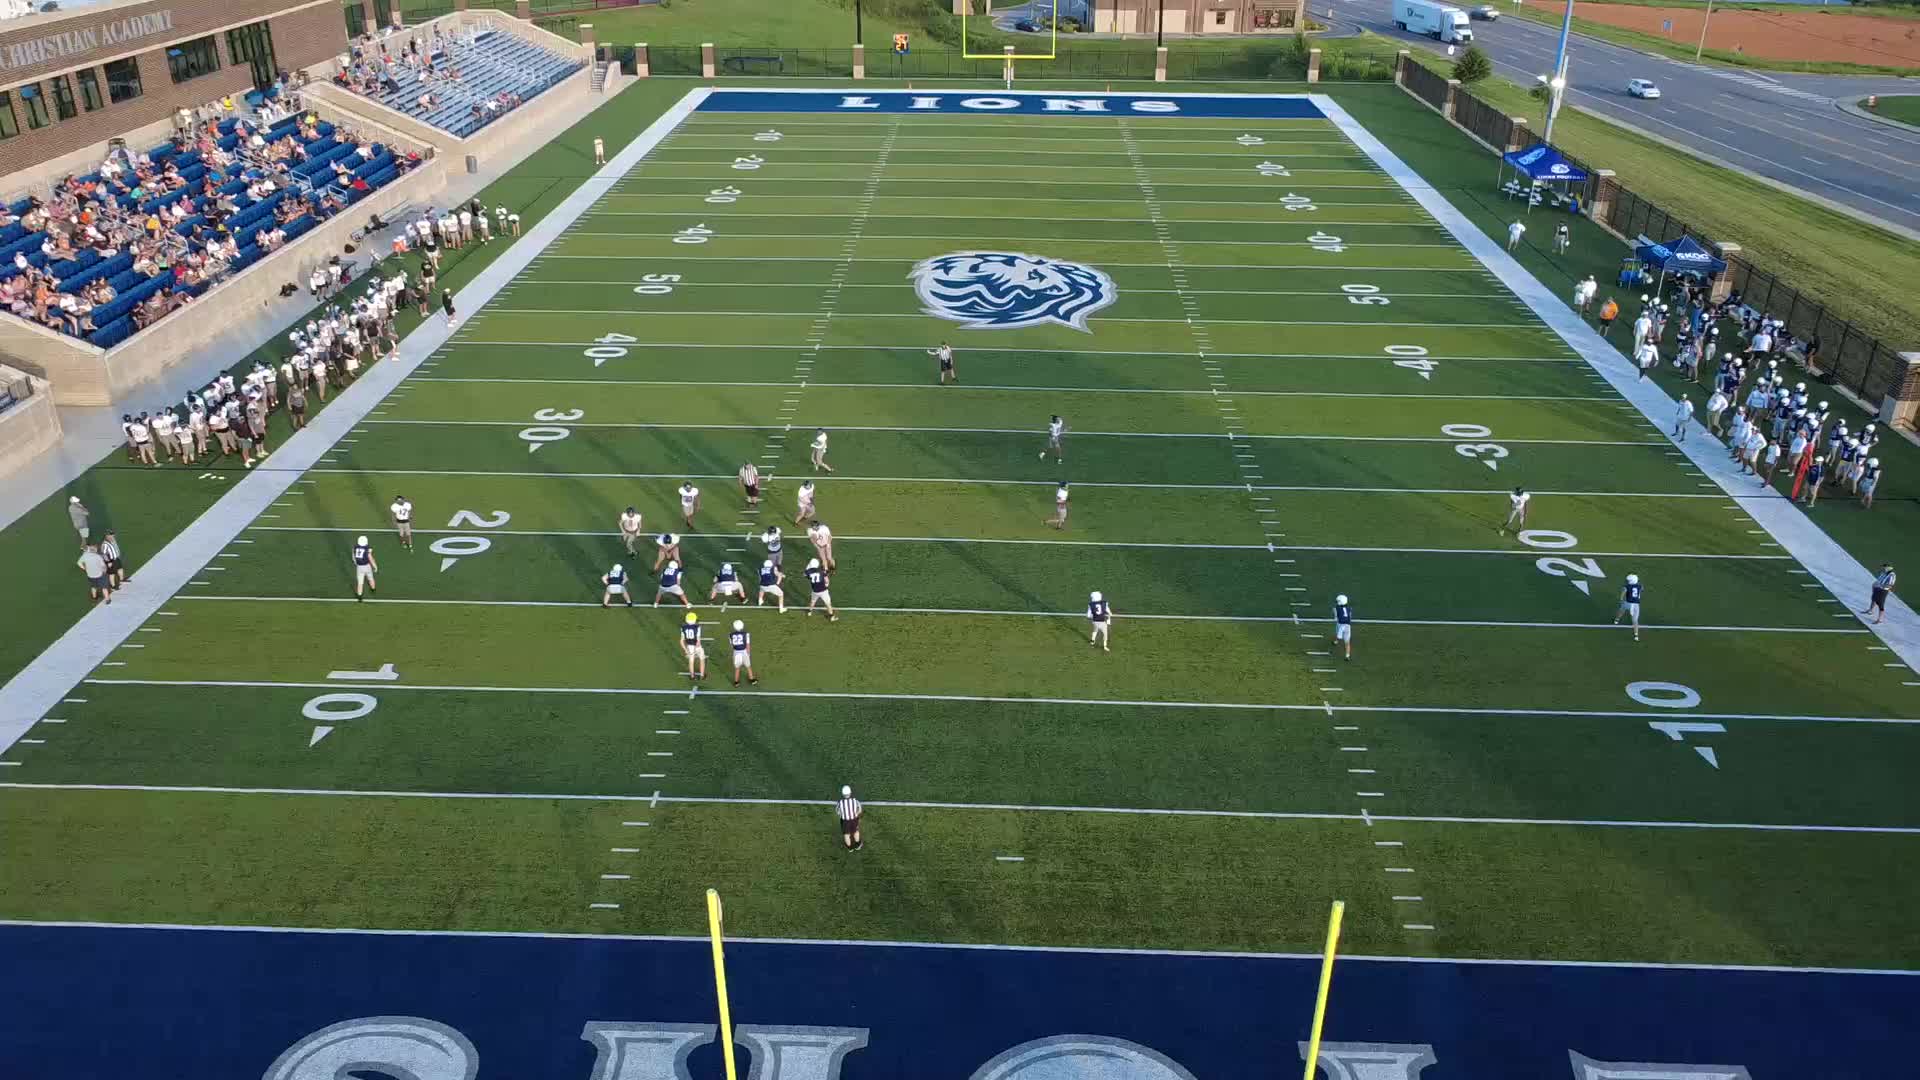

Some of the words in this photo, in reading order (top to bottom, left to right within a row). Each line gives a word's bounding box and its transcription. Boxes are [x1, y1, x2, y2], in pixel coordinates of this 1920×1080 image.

[102, 9, 174, 45] ACADEMY
[836, 96, 1181, 113] LIONS
[731, 156, 764, 170] 20
[704, 188, 742, 203] 30
[1280, 196, 1318, 211] 30
[672, 226, 713, 244] 40
[1307, 235, 1349, 253] 40
[633, 273, 681, 295] 50
[1341, 284, 1390, 305] 50
[584, 332, 638, 358] 40
[1384, 344, 1439, 371] 40
[518, 407, 585, 442] 30
[1441, 423, 1509, 458] 30
[429, 509, 511, 556] 20
[1517, 529, 1607, 579] 20
[1095, 604, 1102, 615] 3
[731, 634, 744, 646] 22
[302, 663, 400, 721] 10
[1625, 681, 1728, 741] 10
